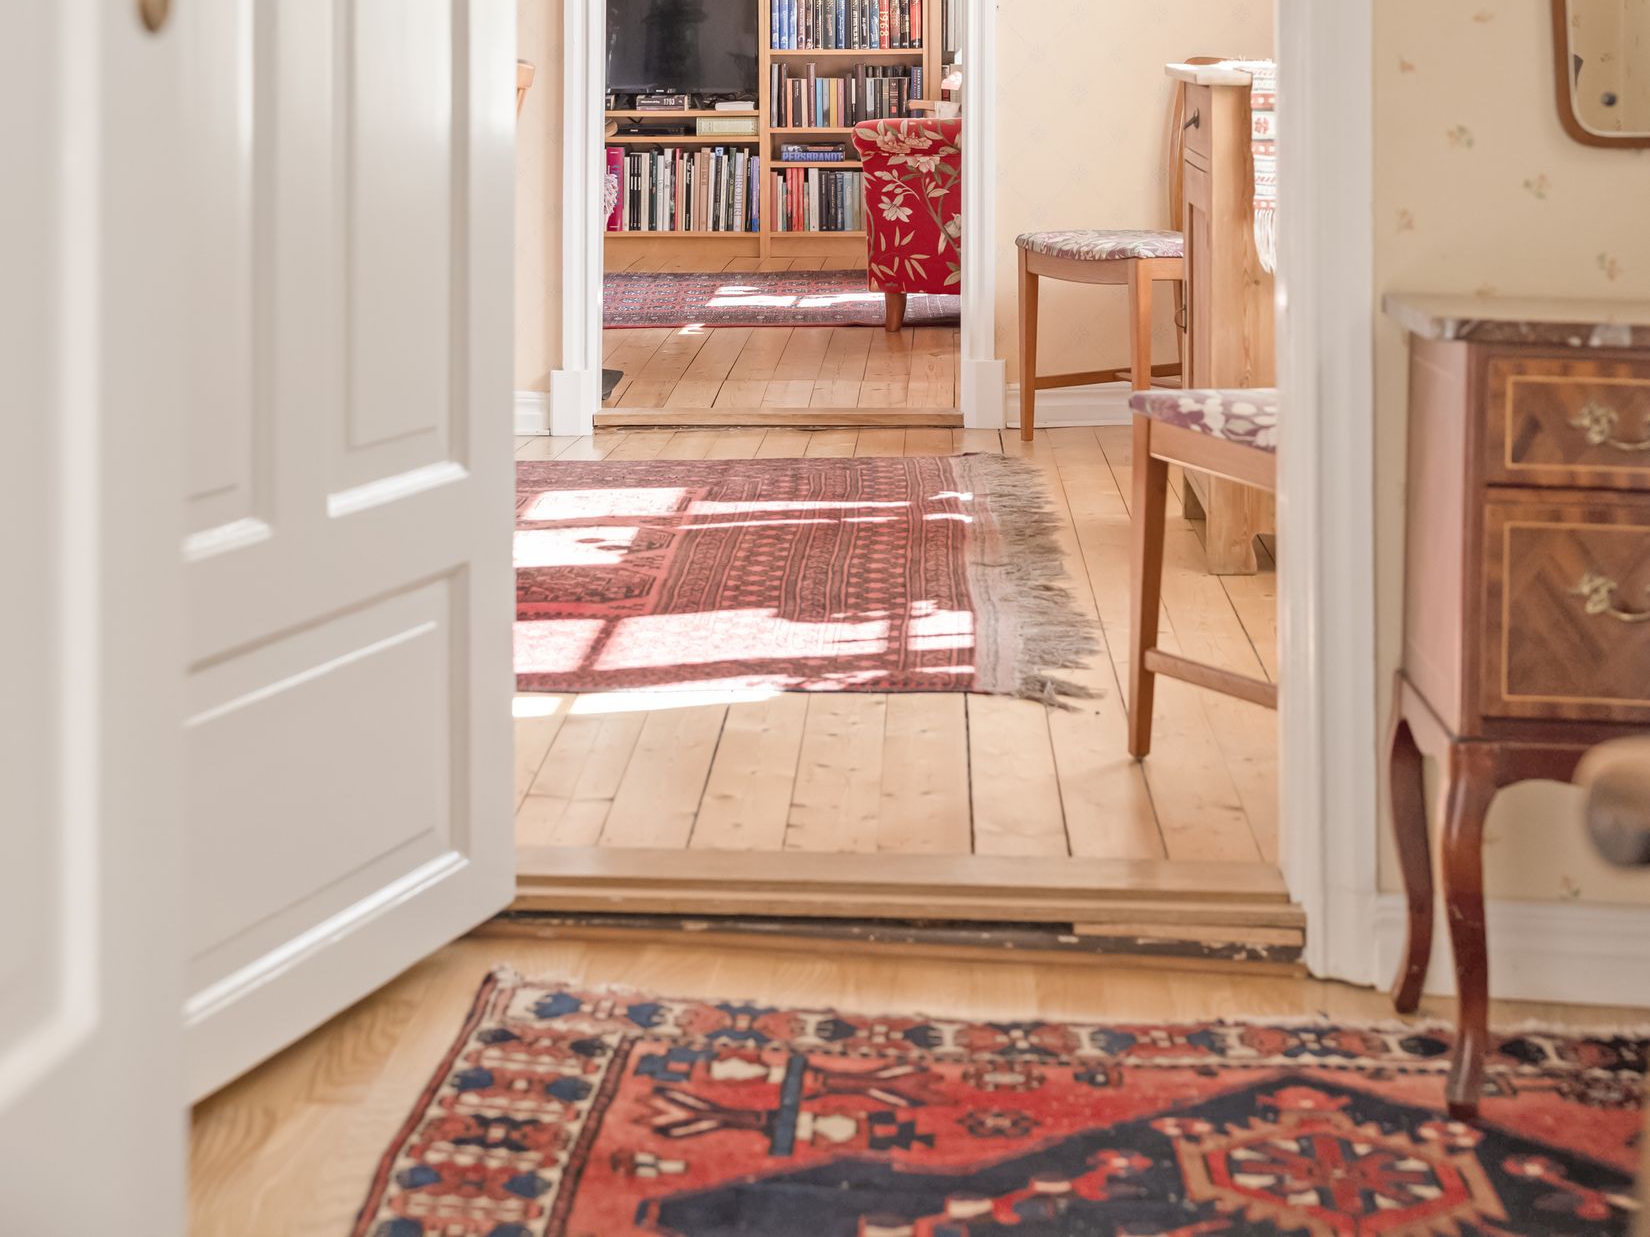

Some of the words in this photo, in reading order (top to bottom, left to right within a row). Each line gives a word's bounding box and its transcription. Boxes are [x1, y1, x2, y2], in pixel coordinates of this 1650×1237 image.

[880, 11, 889, 37] 1968
[663, 98, 675, 106] 1793
[782, 152, 842, 161] PERSBRANDT
